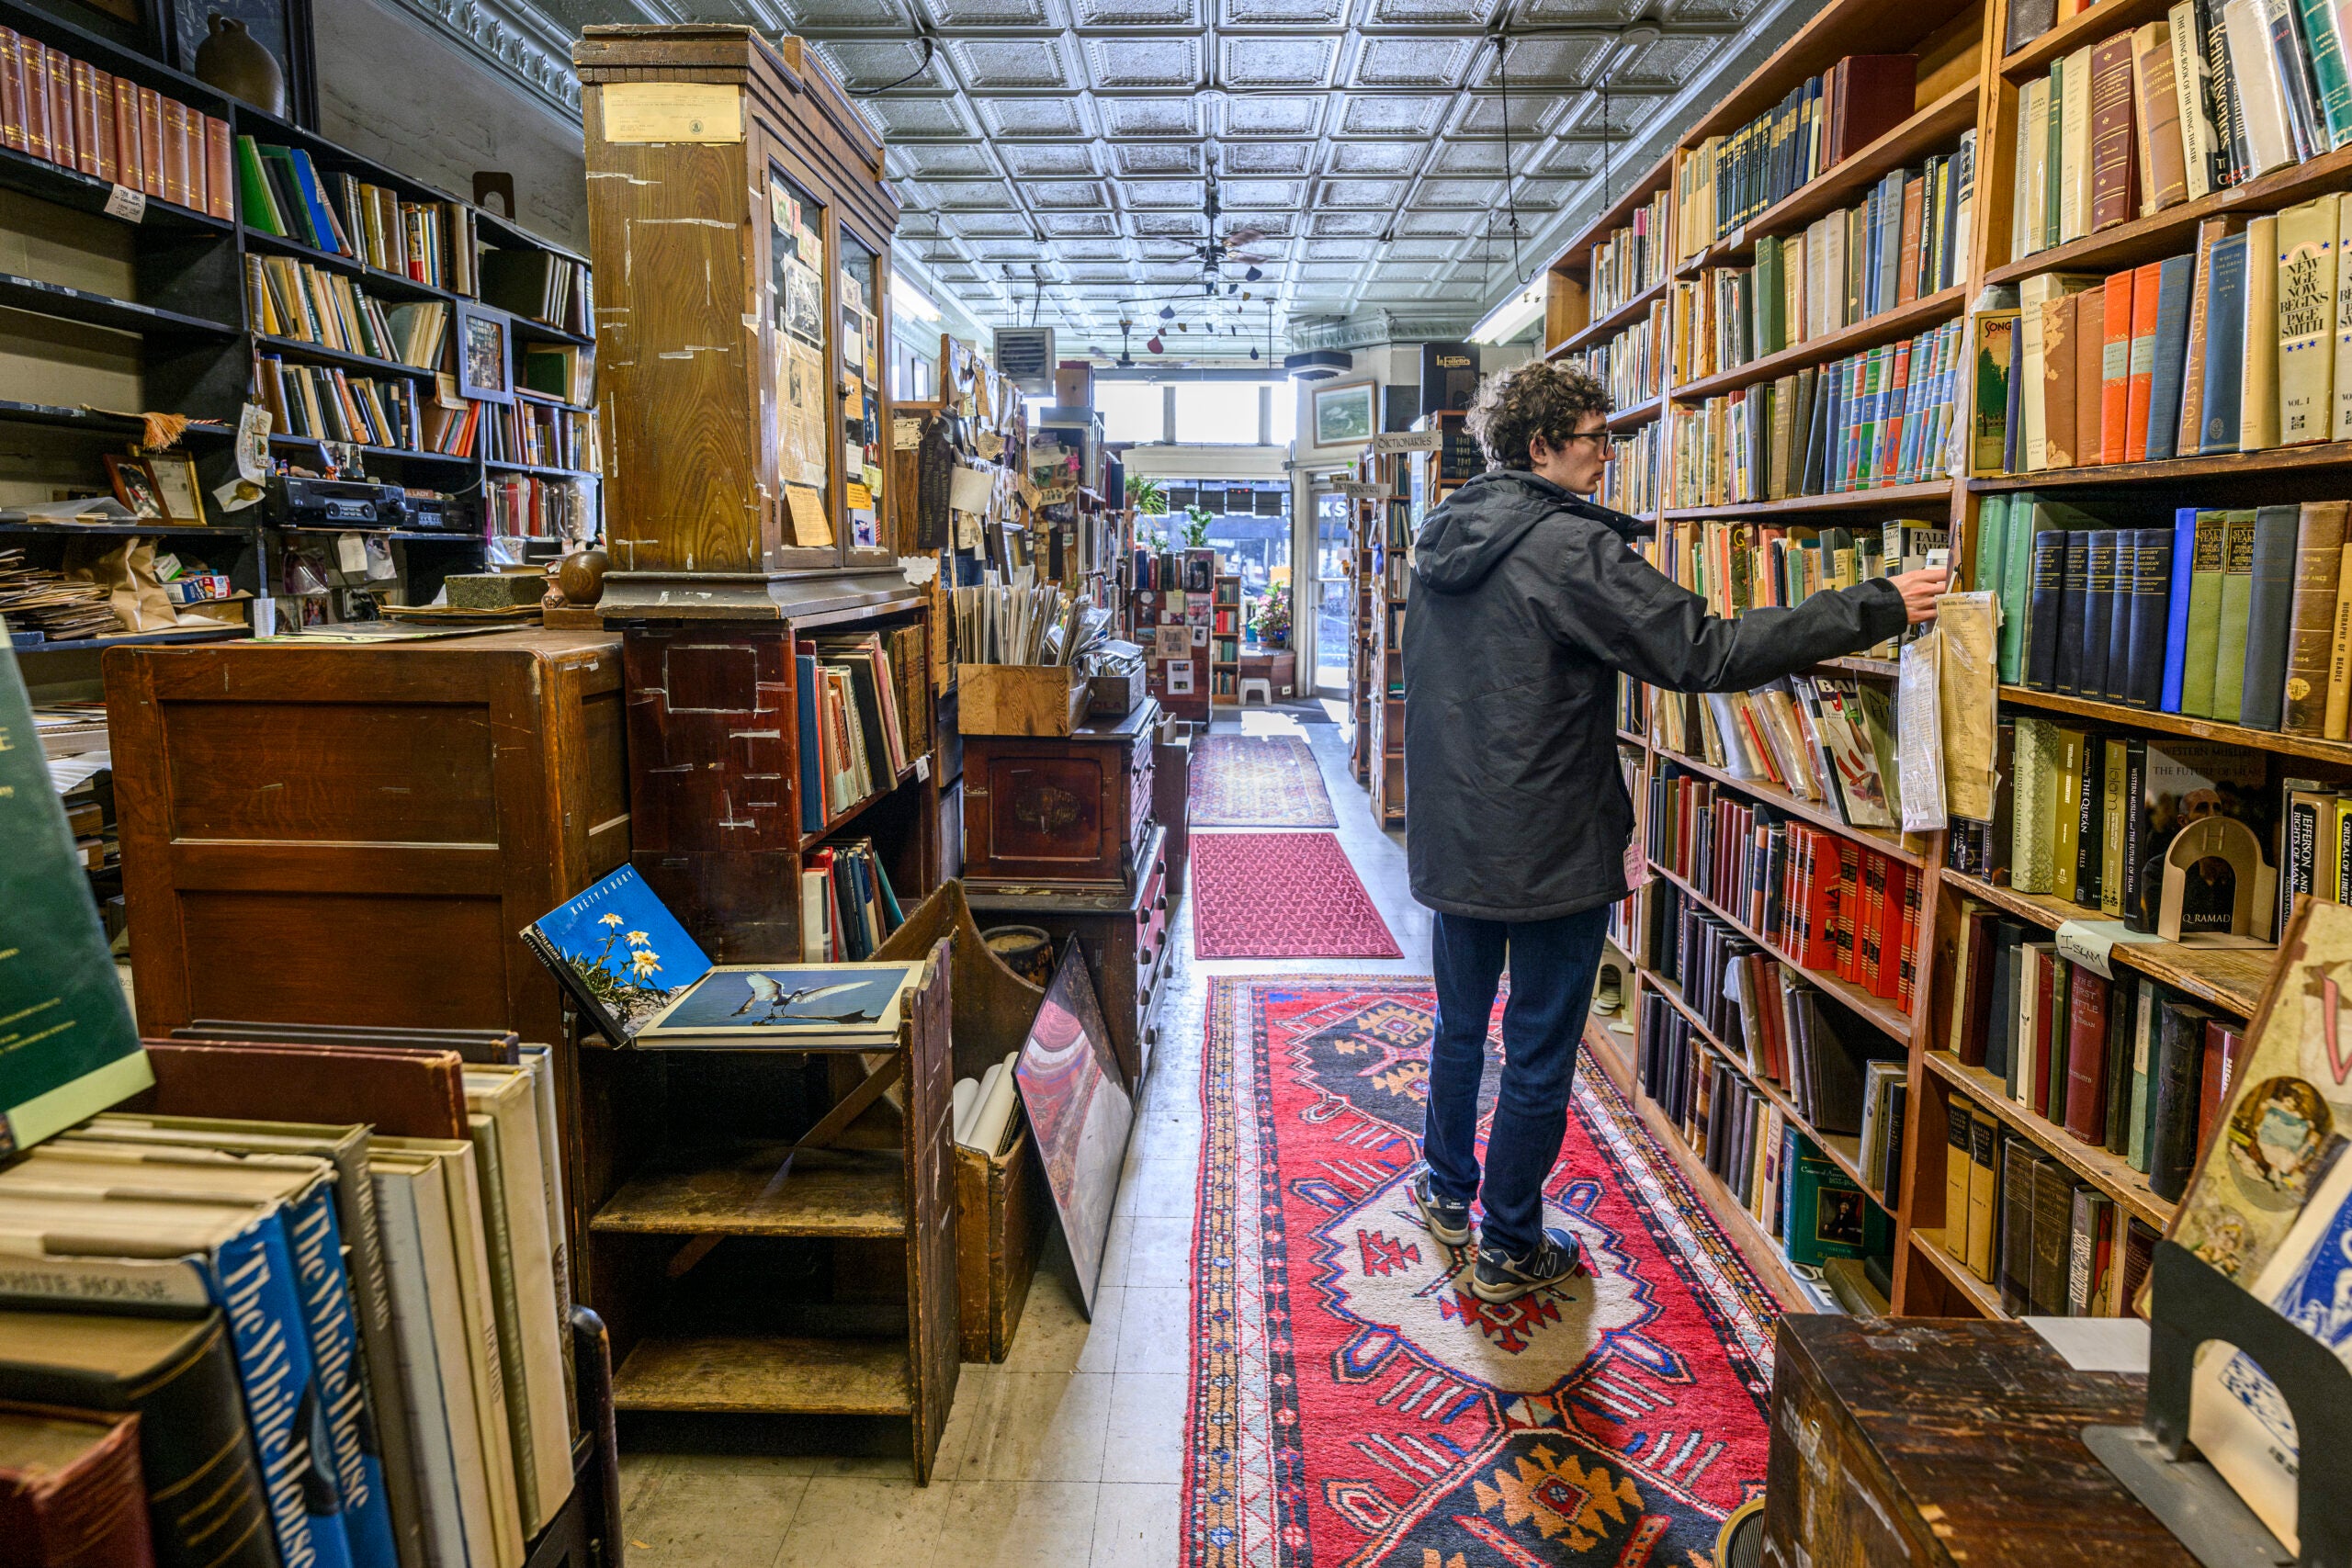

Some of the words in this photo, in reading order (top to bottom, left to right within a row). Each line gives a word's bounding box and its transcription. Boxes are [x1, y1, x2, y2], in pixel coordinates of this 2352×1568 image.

[2178, 31, 2188, 58] LIVING
[2184, 78, 2189, 88] OF
[2208, 22, 2232, 151] Reminiscences
[2186, 104, 2195, 134] LIVING
[2188, 134, 2197, 164] THEATRE
[2300, 249, 2308, 261] A
[2288, 257, 2322, 276] NEW
[2191, 235, 2213, 344] WASHINGTON
[2288, 282, 2320, 299] NOW
[2290, 271, 2316, 288] AGE
[2279, 291, 2329, 314] BEGINS
[2286, 307, 2320, 326] PAGE
[1984, 321, 2012, 338] SONG
[2281, 318, 2324, 339] SMITH
[1377, 435, 1432, 449] DICTIONARIES
[413, 489, 430, 498] LADY
[1914, 531, 1949, 544] TALE
[2342, 603, 2350, 640] BIOGRAPHY
[2338, 644, 2345, 653] OF
[2335, 658, 2344, 683] BEADLE
[2153, 765, 2175, 776] THE
[2082, 778, 2091, 793] THE
[2108, 767, 2122, 811] Islam
[2293, 811, 2301, 846] RIGHTS
[2342, 821, 2351, 857] ORDEAL
[2293, 846, 2301, 858] OF
[2301, 813, 2314, 869] JEFFERSON
[2291, 861, 2300, 886] MAN
[2342, 860, 2349, 873] OF
[610, 870, 634, 890] HORY
[2300, 872, 2310, 895] AND
[2195, 913, 2232, 924] RAMAD
[2061, 933, 2105, 968] ISLAM
[2073, 985, 2097, 1000] FIRST
[2076, 976, 2093, 988] THE
[292, 1197, 333, 1282] The
[223, 1240, 272, 1334] The
[308, 1273, 352, 1397] White
[242, 1320, 296, 1457] White
[327, 1387, 371, 1511] House
